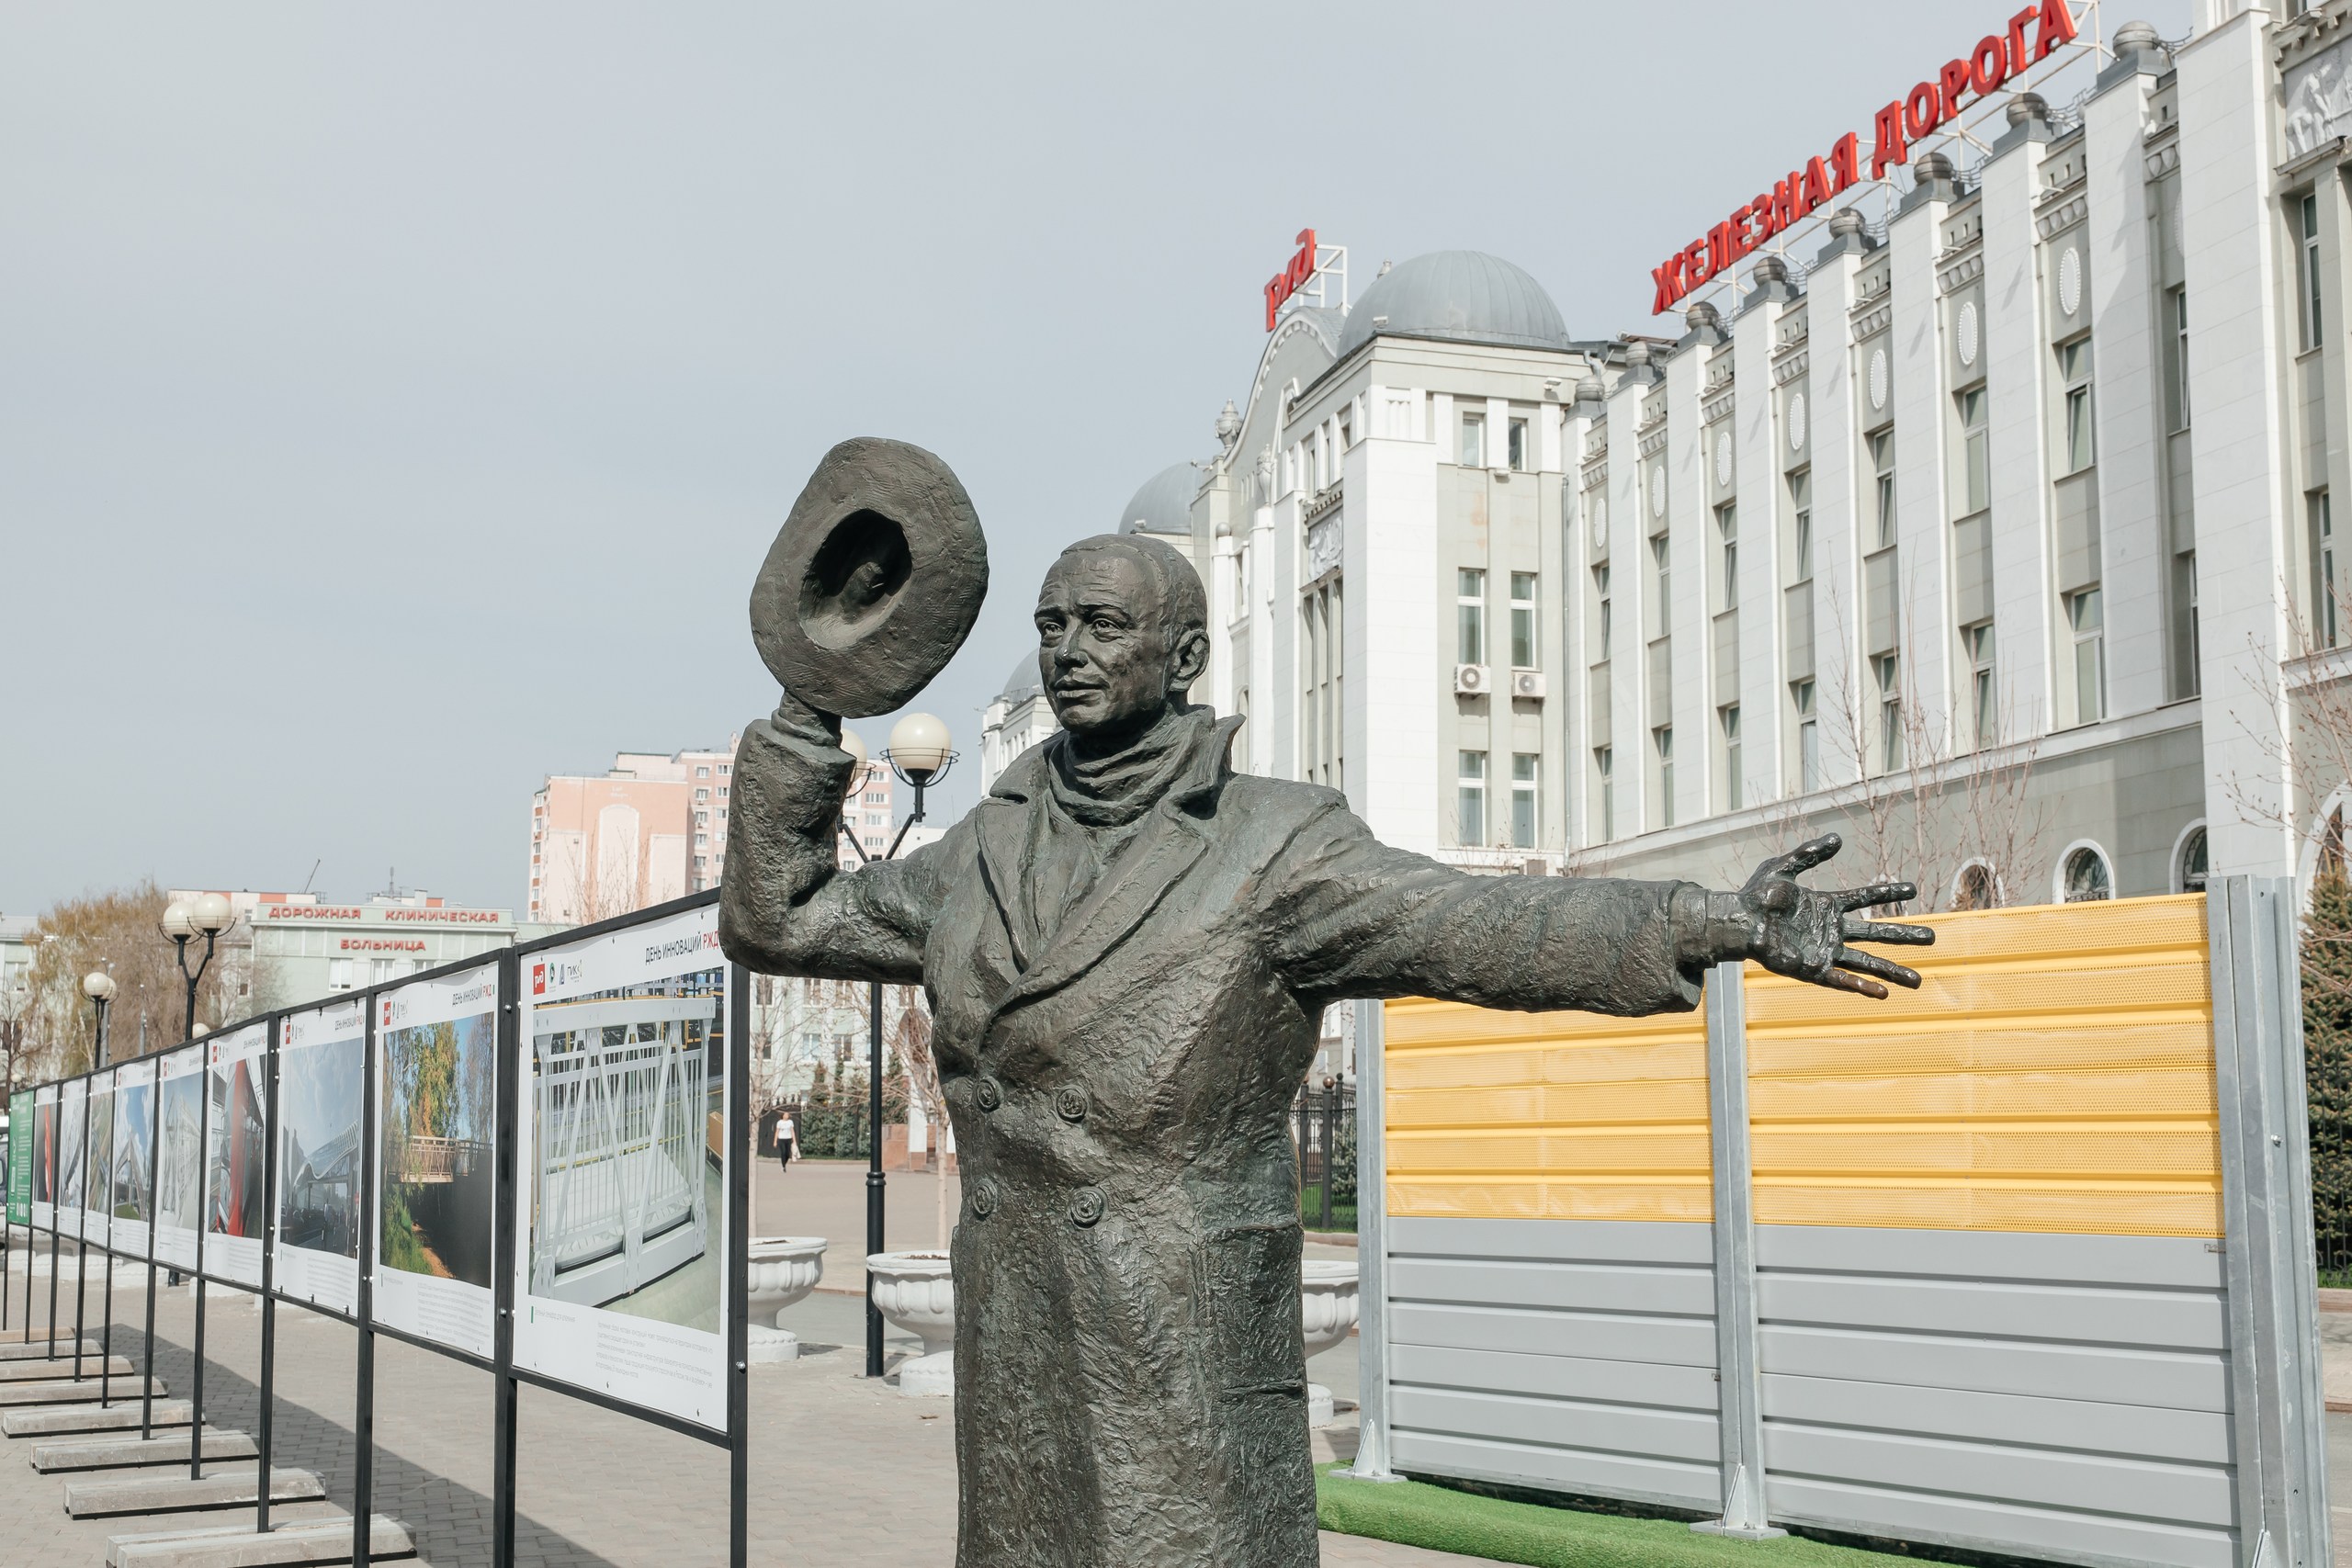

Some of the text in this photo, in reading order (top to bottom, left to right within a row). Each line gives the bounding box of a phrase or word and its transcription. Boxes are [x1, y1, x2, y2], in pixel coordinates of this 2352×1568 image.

[1651, 0, 2078, 315] ЖЕЛЕЗНАЯ ДОРОГА
[268, 906, 499, 923] ДОРОЖНАЯ КЛИНИЧЕСКАЯ
[340, 939, 426, 952] БОЛЬНИЦА
[645, 930, 719, 965] ДЕНЬ ИННОВАЦИЙ РЖД
